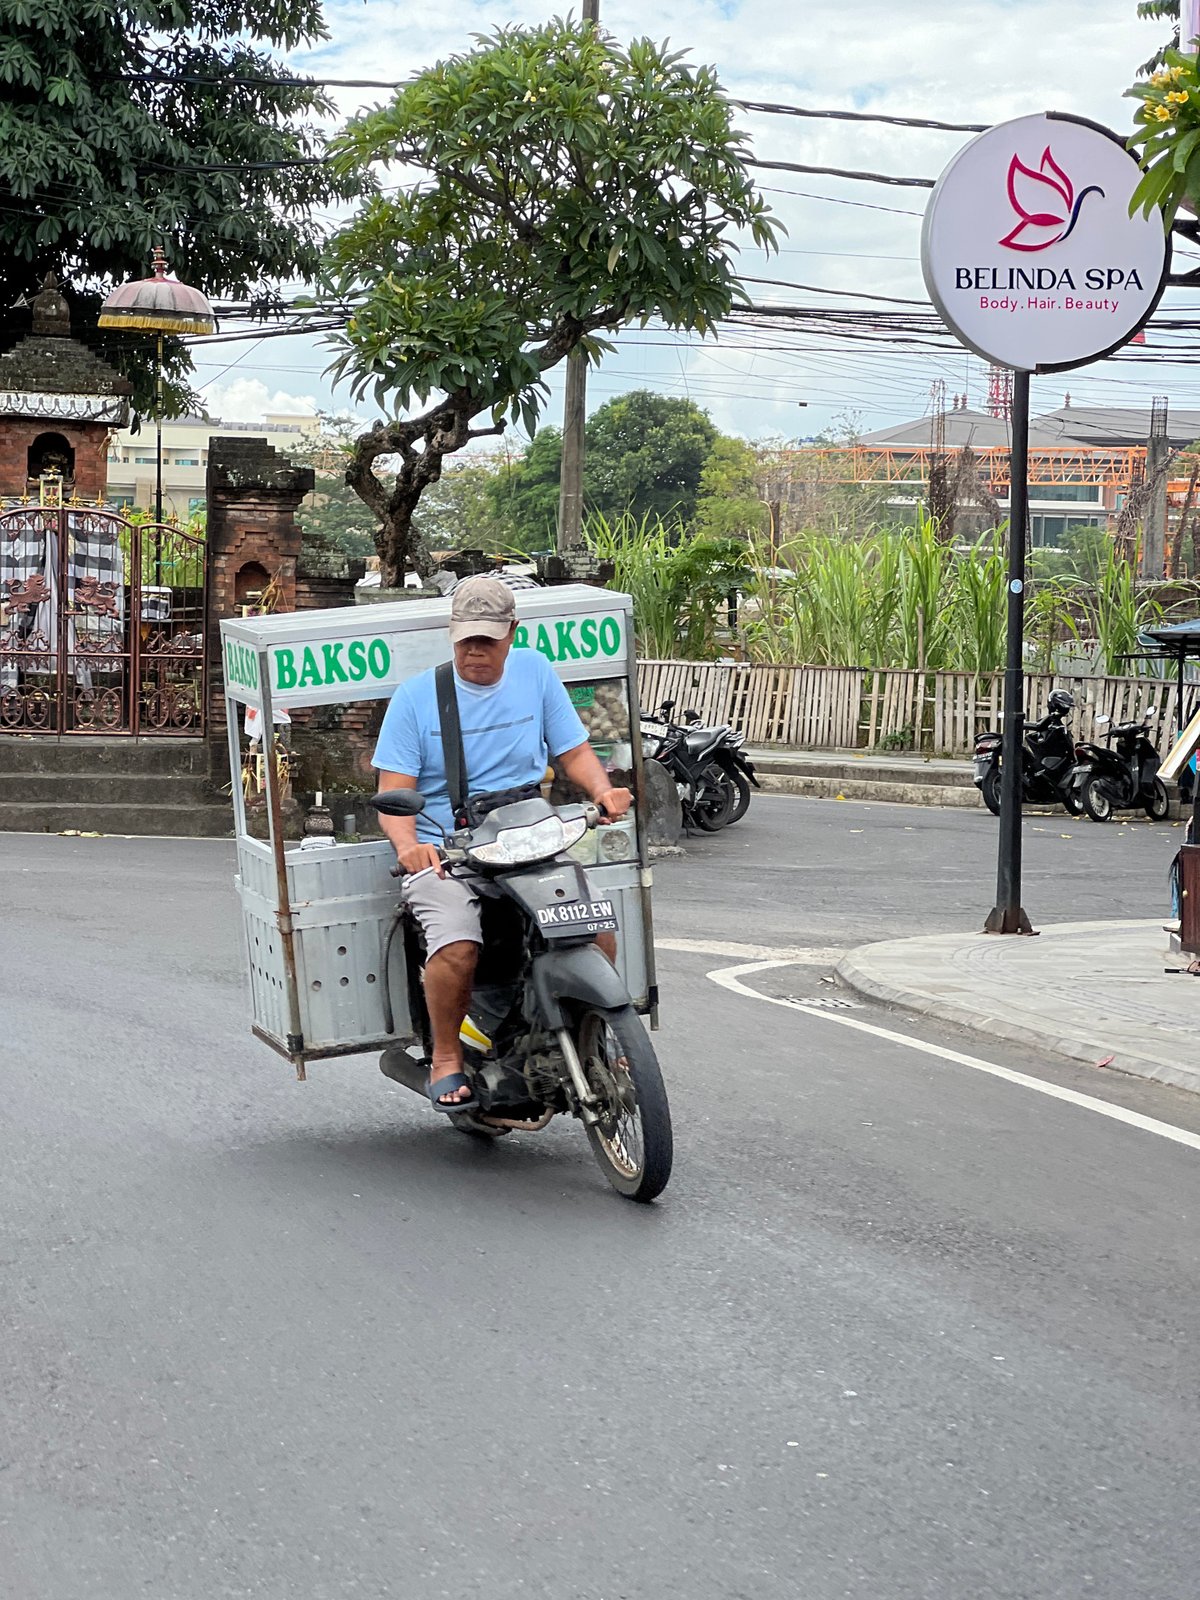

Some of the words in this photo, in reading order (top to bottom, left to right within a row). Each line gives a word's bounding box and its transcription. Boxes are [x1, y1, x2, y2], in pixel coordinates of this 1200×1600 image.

[955, 267, 1076, 290] BELINDA
[1084, 268, 1144, 291] SPA
[1065, 297, 1119, 312] Beauty
[227, 641, 258, 691] BAKSO
[274, 638, 391, 690] BAKSO
[537, 907, 559, 924] DK
[558, 904, 590, 921] 8112
[590, 901, 613, 918] EW
